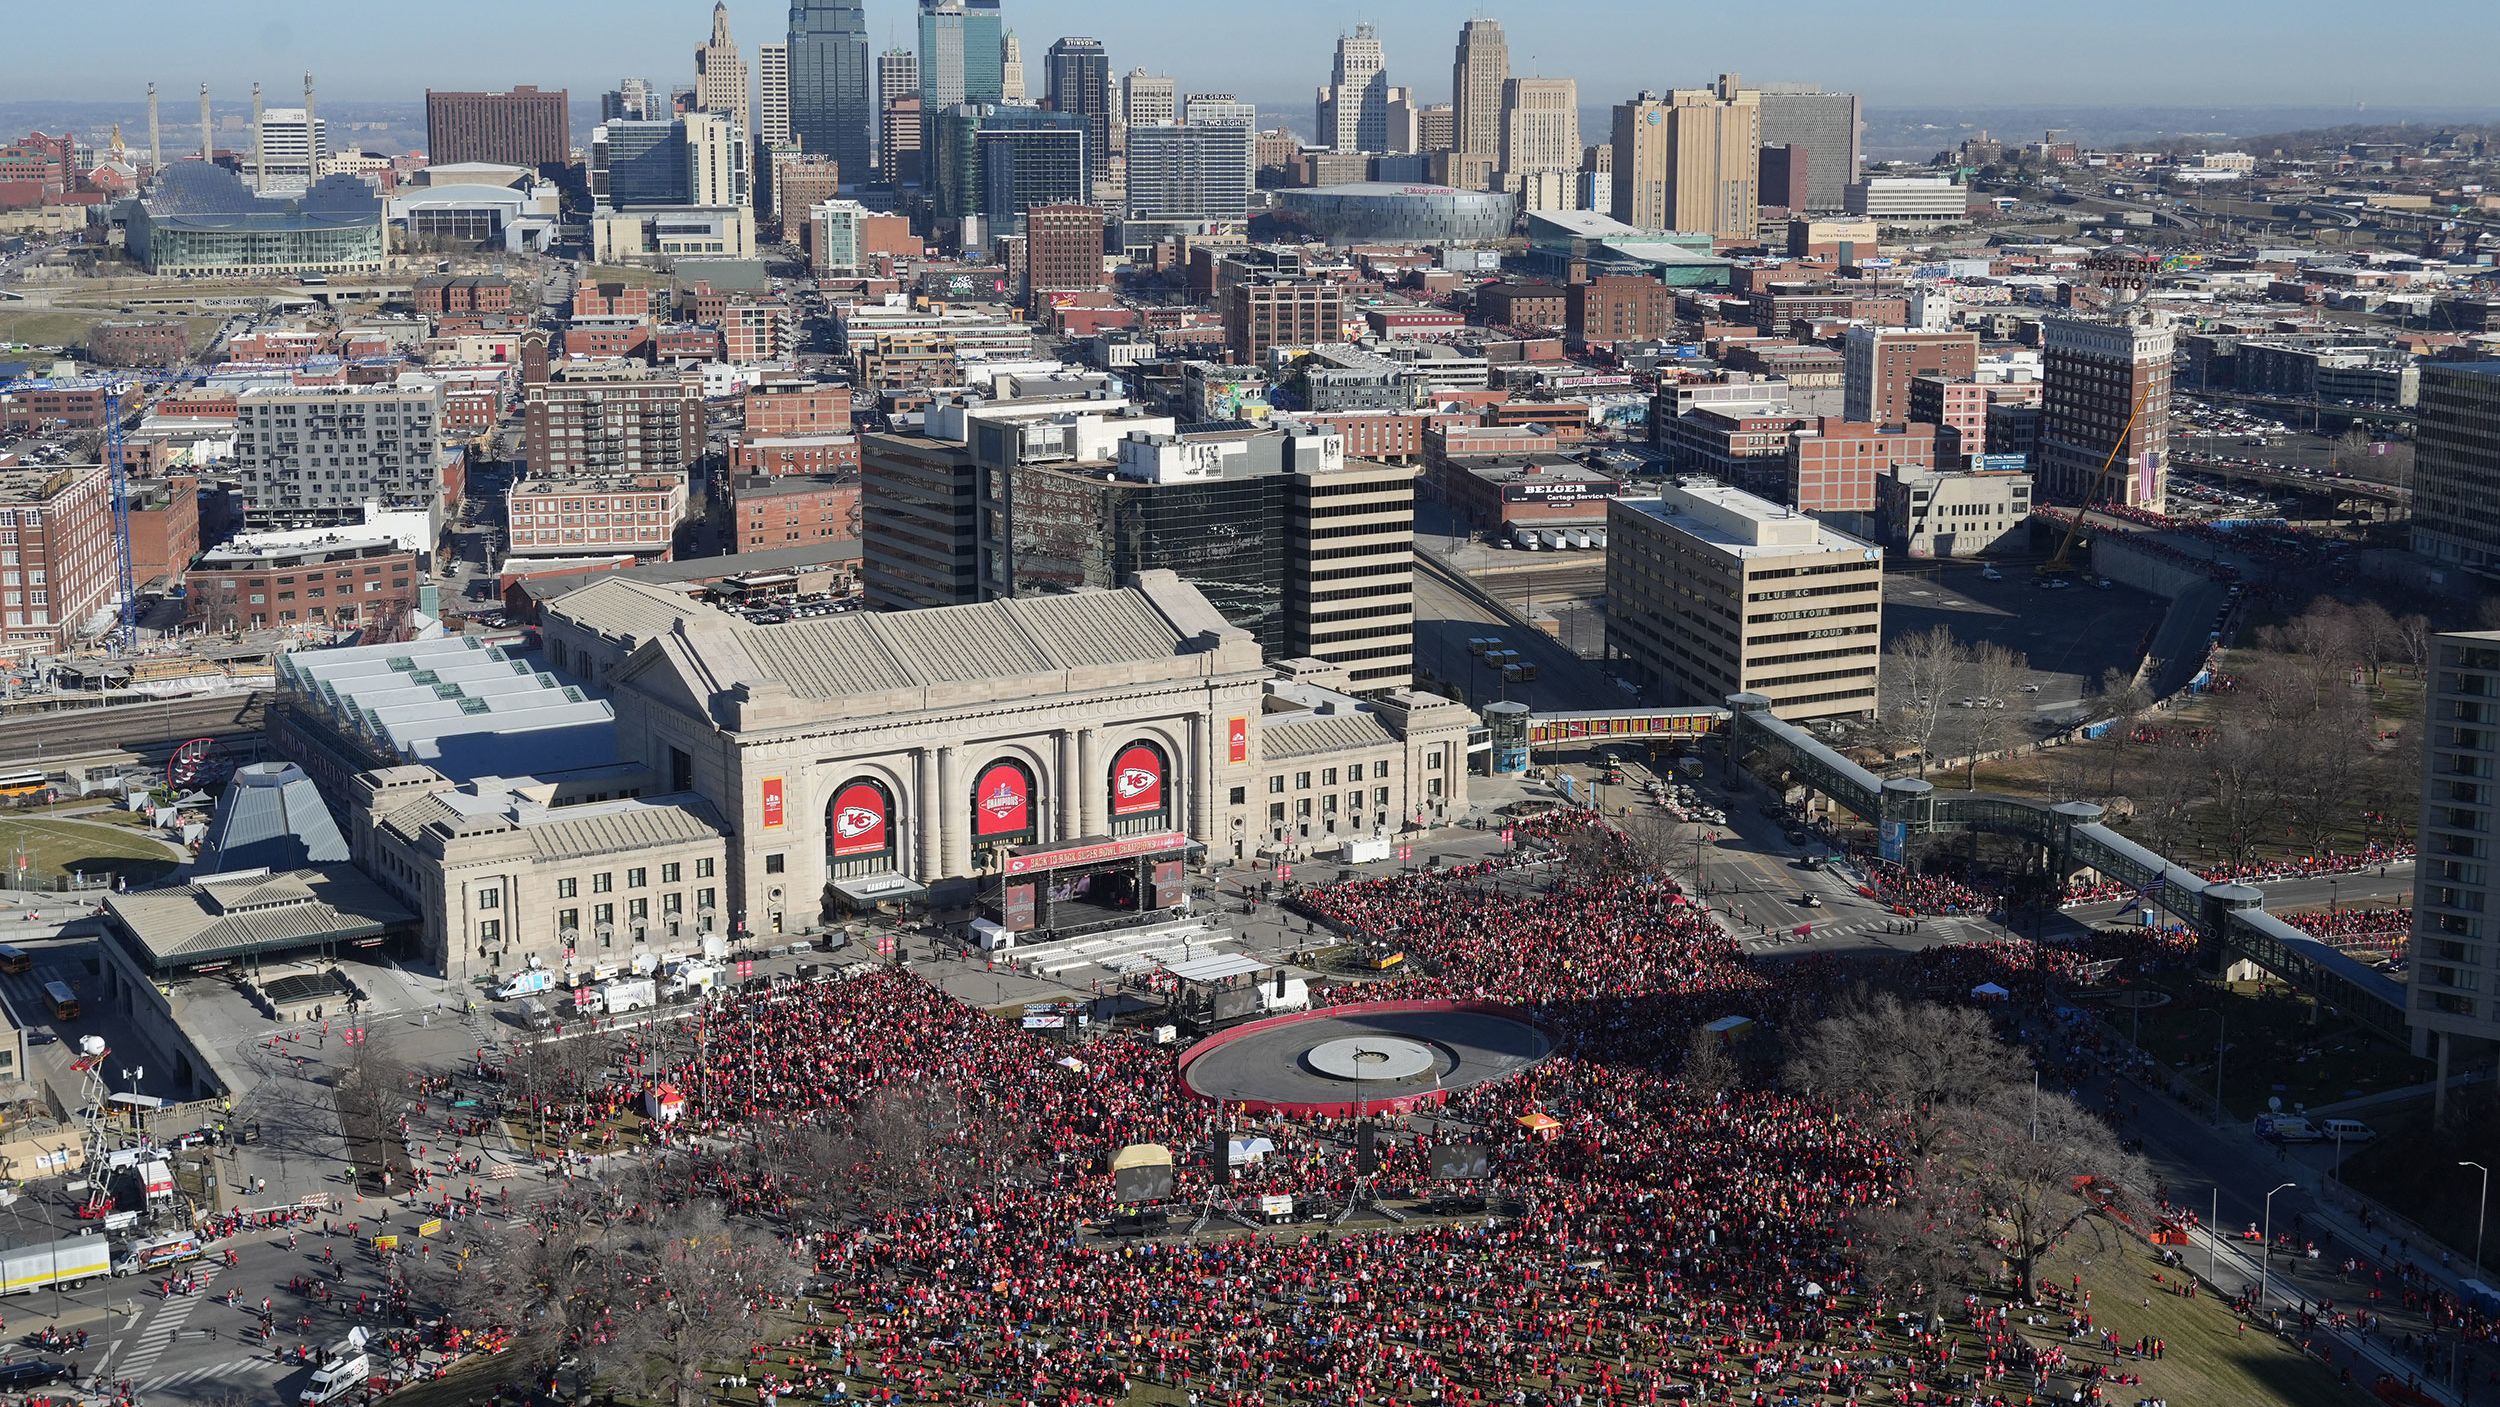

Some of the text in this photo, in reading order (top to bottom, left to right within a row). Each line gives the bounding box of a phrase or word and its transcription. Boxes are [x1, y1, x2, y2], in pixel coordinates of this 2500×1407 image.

[2084, 258, 2159, 273] WESTERN
[2100, 276, 2142, 290] AUTO
[1525, 484, 1587, 494] BELGER
[1760, 589, 1809, 601] BLUE KC
[1773, 608, 1830, 620] HOMETOWN
[1808, 628, 1843, 639] PROUD
[1031, 839, 1156, 868] BACK TO BACK SUPER BOWL CHAMPIONS
[867, 879, 905, 892] KANSAS CITY
[336, 1368, 354, 1385] KMBC
